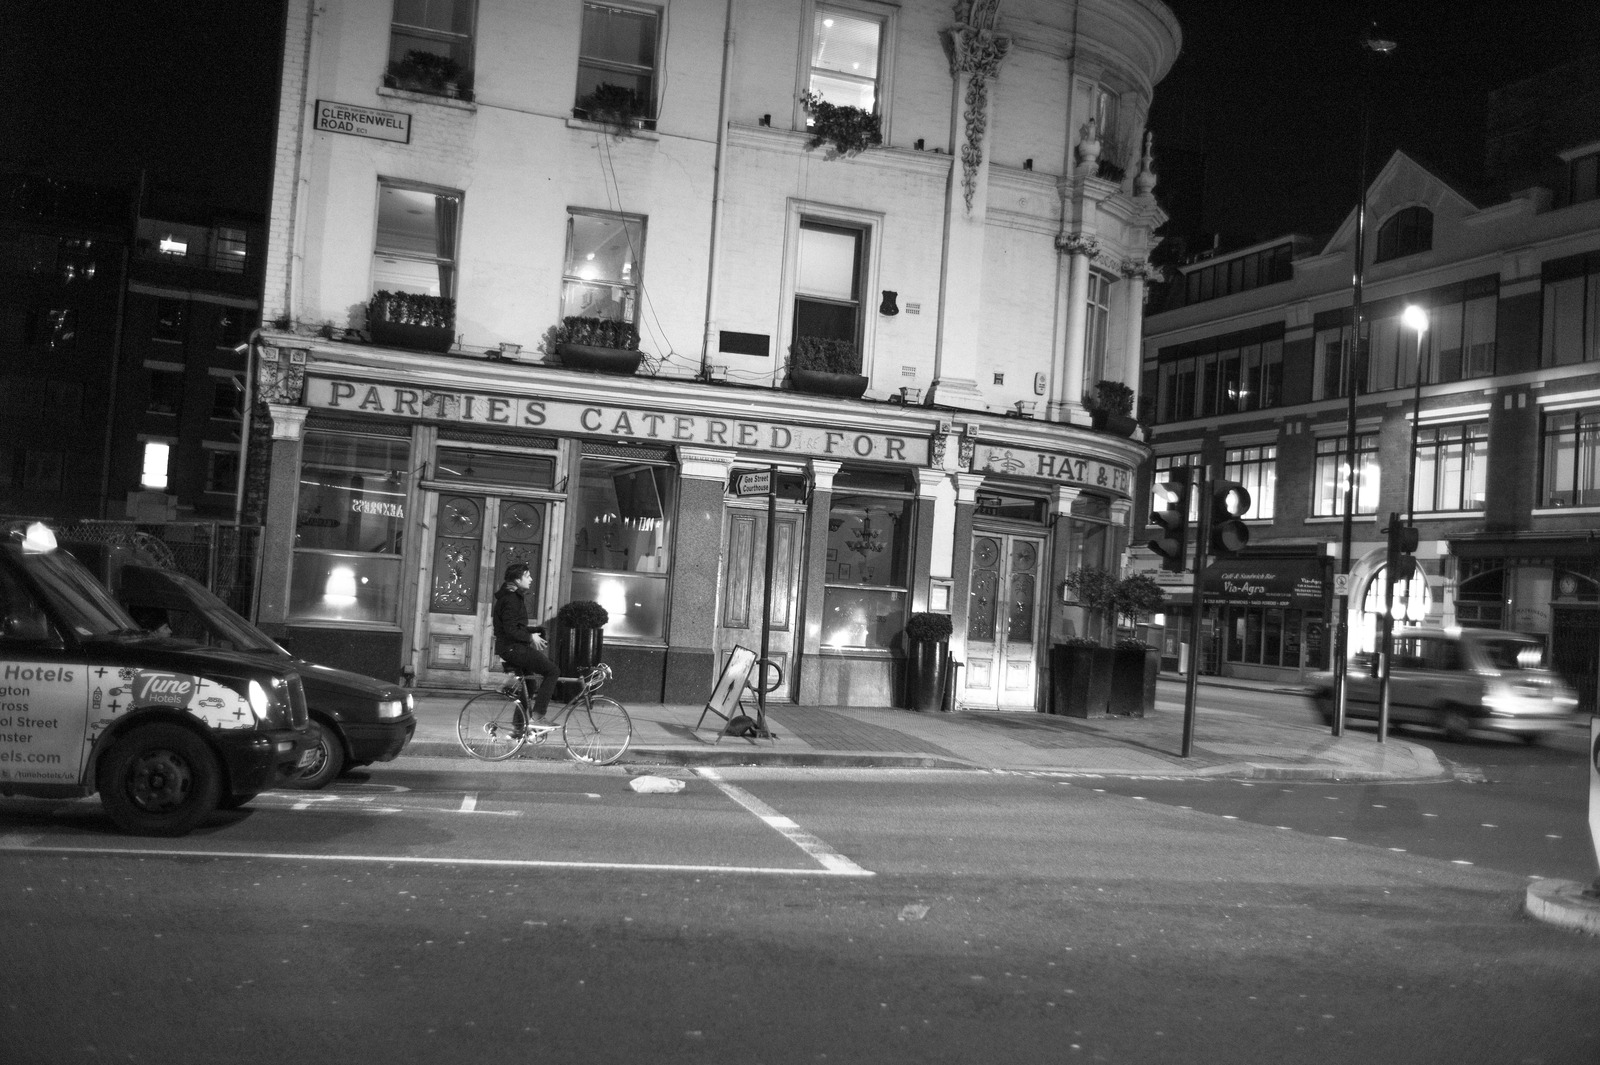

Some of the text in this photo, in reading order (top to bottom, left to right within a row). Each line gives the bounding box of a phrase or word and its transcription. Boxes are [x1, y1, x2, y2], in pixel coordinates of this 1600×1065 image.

[321, 118, 354, 132] ROAD
[322, 108, 404, 130] CLERKENWELL
[327, 382, 907, 461] PARTIES CATERED FOR
[1036, 454, 1088, 482] HAT
[1097, 466, 1108, 487] &
[754, 474, 768, 483] Street
[1224, 581, 1265, 595] Via-Agra
[4, 665, 74, 682] Hotels
[140, 672, 191, 699] Tune
[149, 693, 182, 703] Hotels
[17, 717, 58, 729] Street
